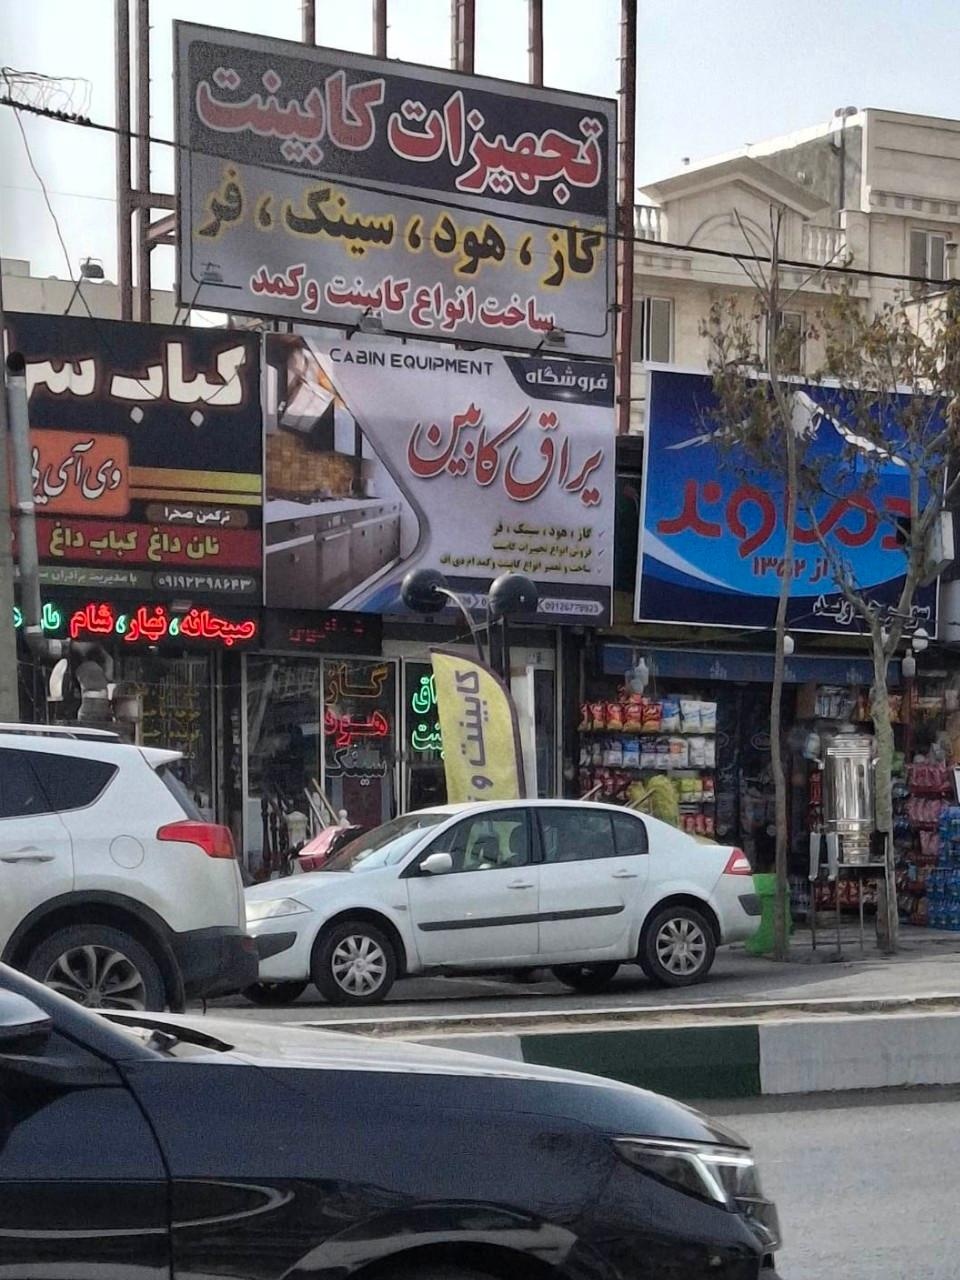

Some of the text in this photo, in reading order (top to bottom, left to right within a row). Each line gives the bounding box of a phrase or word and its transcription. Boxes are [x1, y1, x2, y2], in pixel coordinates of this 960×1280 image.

[196, 67, 604, 204] تجهیزات کابینت
[198, 168, 243, 238] فر
[324, 276, 410, 315] کابینت
[410, 286, 476, 332] انواع
[479, 297, 555, 333] ساخت
[329, 348, 494, 377] CABIN EQUIPMENT
[525, 367, 609, 392] فروشگاه
[110, 342, 246, 428] کباب
[42, 438, 96, 498] آی
[406, 401, 606, 509] یراق کابین
[81, 457, 123, 500] وی
[164, 506, 232, 525] ترکمن صحرا
[655, 478, 912, 559] دموند
[50, 521, 220, 561] نان داغ کباب داغ
[69, 601, 115, 639] شام
[323, 663, 390, 705] گاز
[454, 669, 489, 767] کابینت
